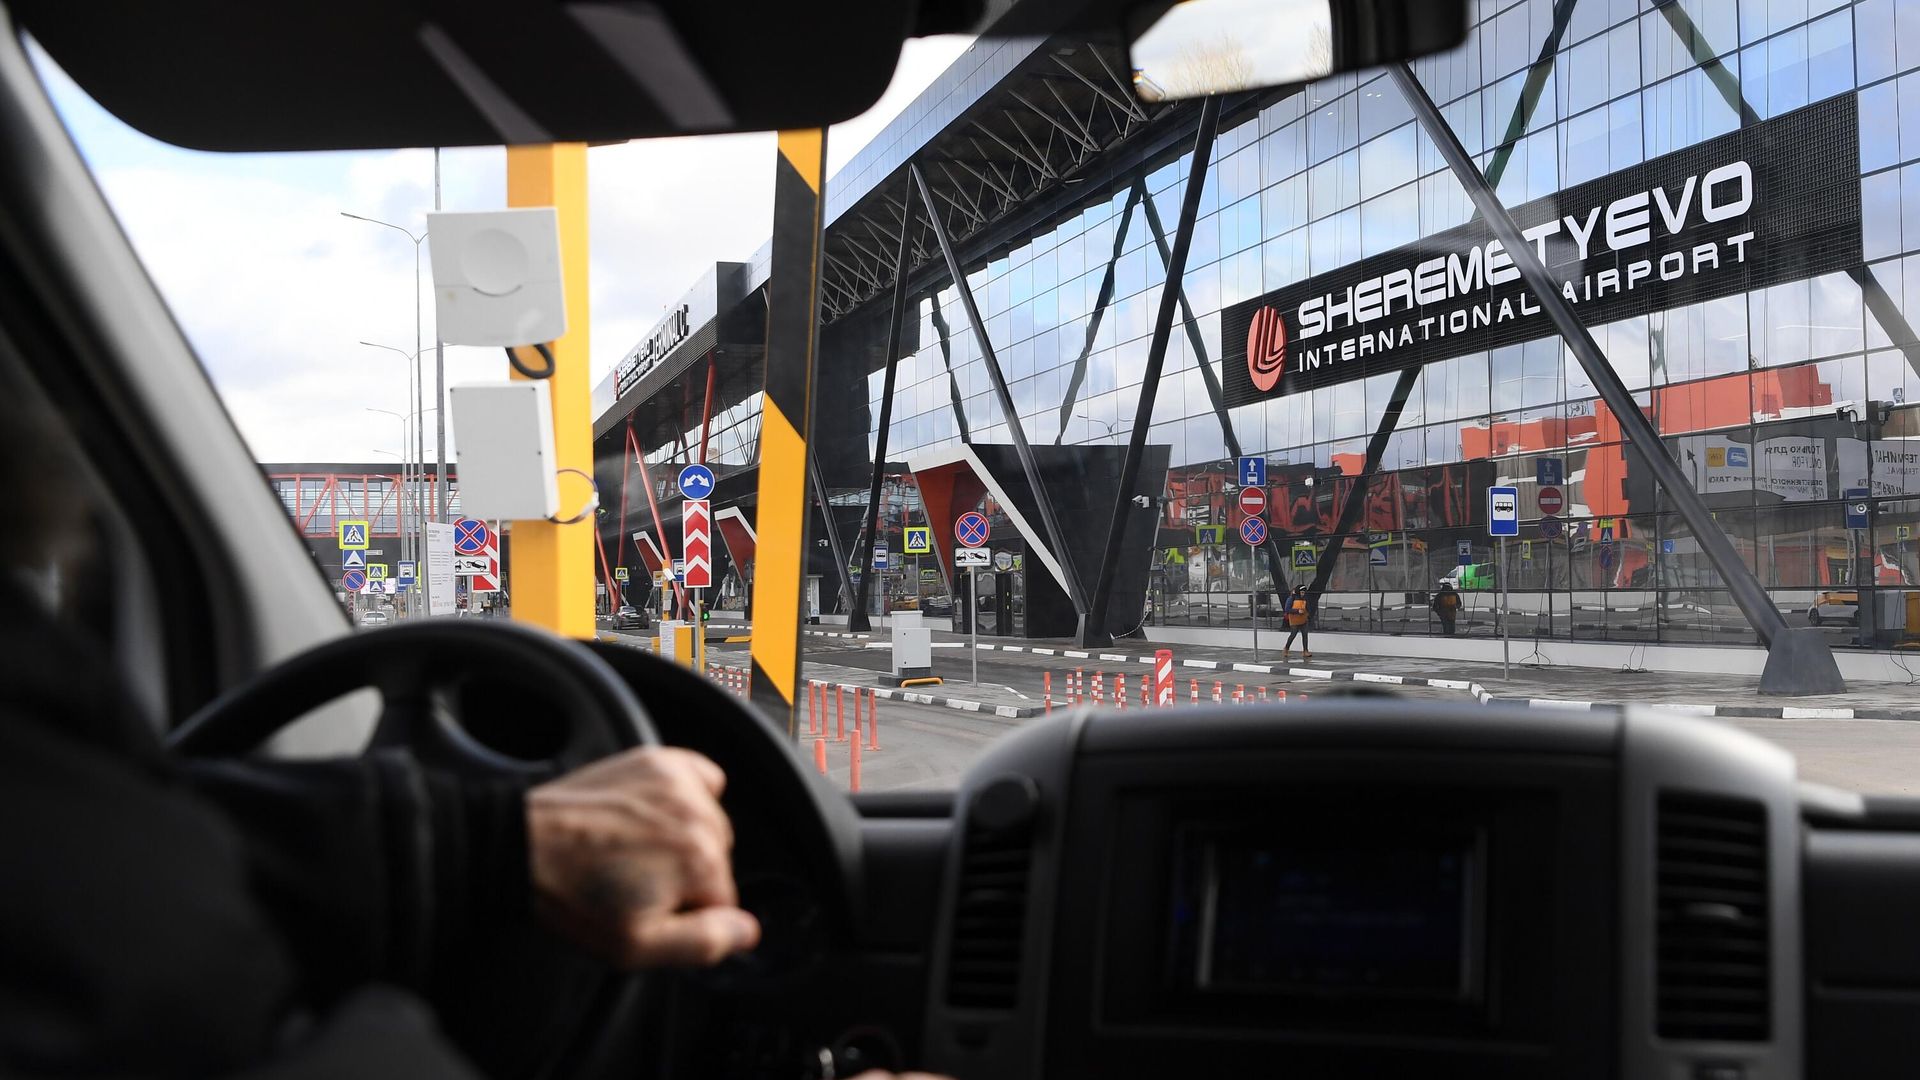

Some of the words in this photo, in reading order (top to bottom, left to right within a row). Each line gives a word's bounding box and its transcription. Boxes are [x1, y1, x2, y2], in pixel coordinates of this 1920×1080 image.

[1298, 161, 1753, 340] SHEREMETYEVO
[1299, 292, 1541, 373] INTERNATIONAL
[1562, 231, 1754, 304] AIRPORT
